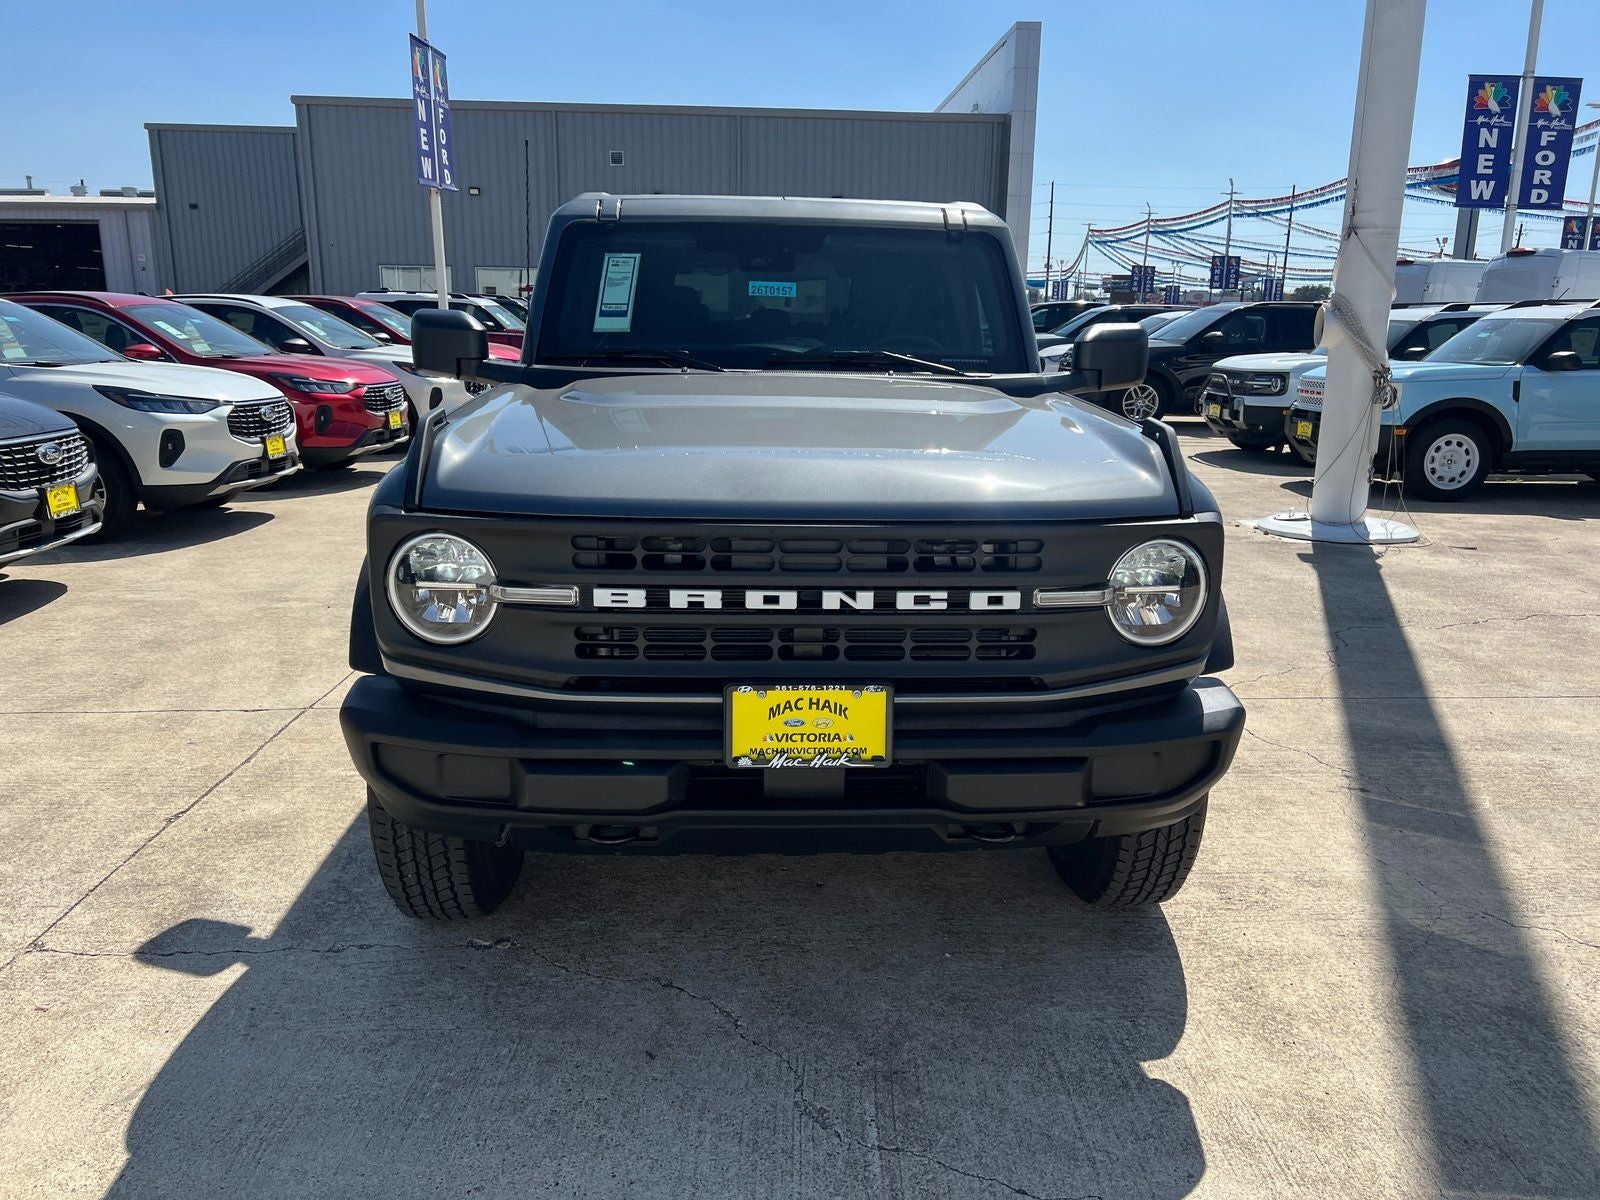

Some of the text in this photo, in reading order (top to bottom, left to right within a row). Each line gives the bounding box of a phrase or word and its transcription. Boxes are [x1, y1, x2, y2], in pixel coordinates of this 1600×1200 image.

[417, 98, 432, 180] NEW
[438, 107, 452, 185] FORD
[1470, 127, 1499, 200] NEW
[1529, 131, 1557, 204] FORD
[1212, 268, 1220, 288] NEW
[751, 285, 793, 296] 26T0157
[593, 588, 1021, 610] BRONCO
[768, 697, 849, 721] MAC HAIK
[775, 732, 843, 743] VICTORIA
[750, 747, 867, 755] MACHAIKVICTORIA.COM
[768, 752, 850, 769] Mac Haik
